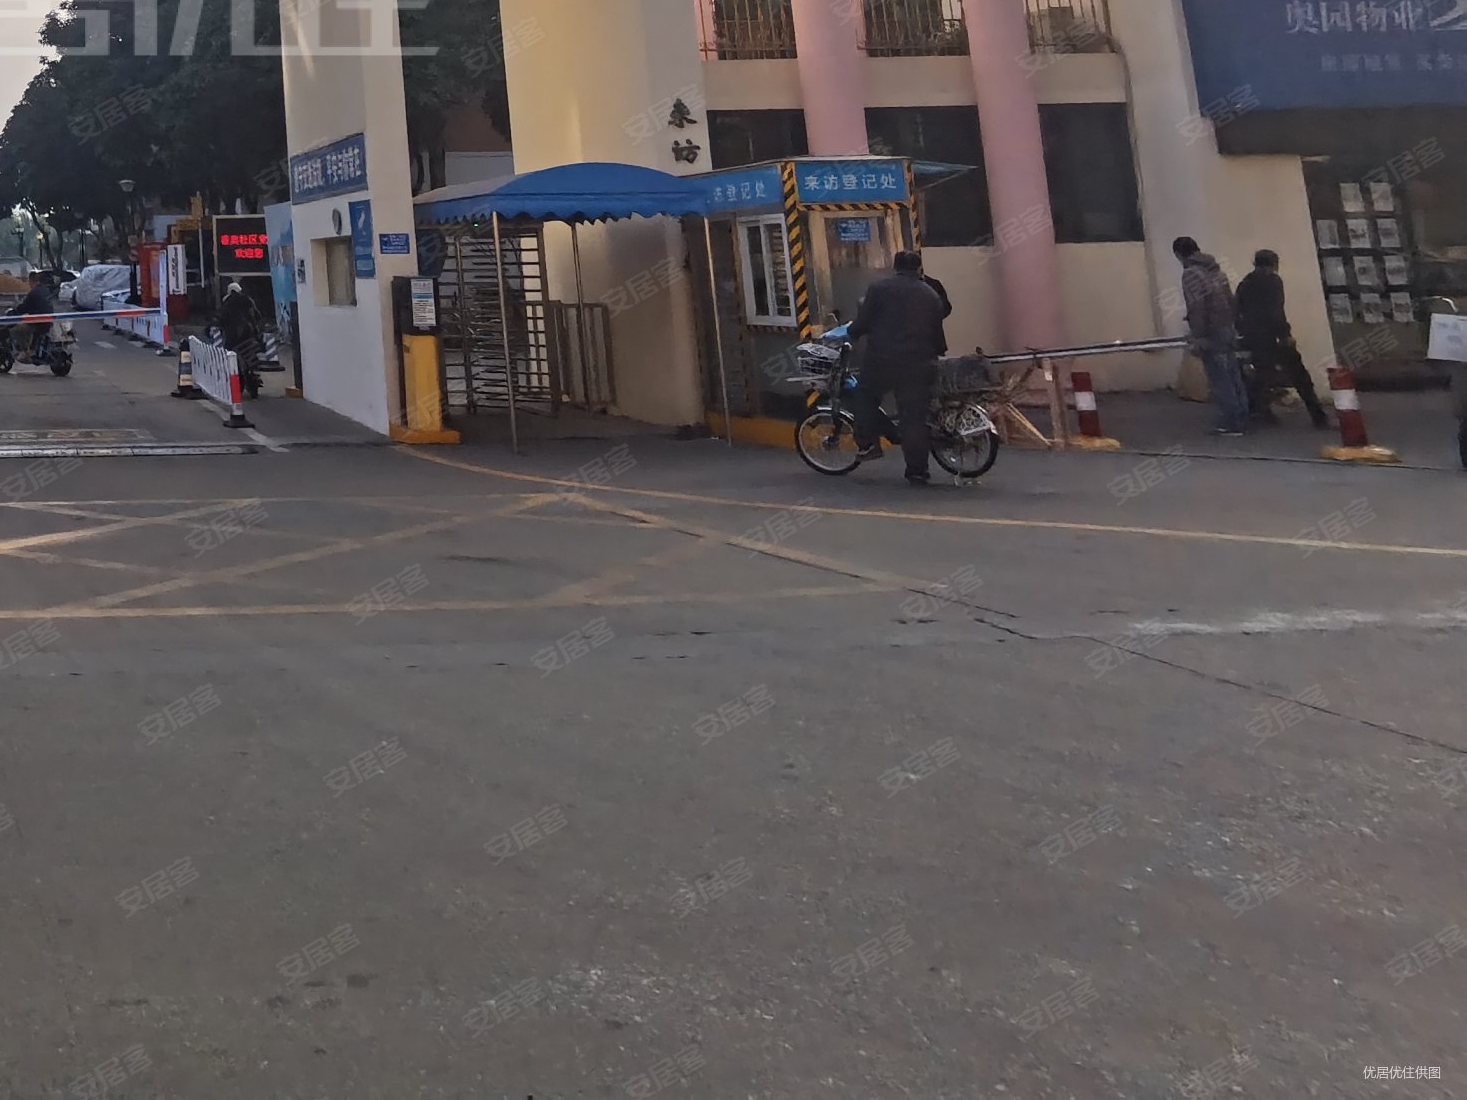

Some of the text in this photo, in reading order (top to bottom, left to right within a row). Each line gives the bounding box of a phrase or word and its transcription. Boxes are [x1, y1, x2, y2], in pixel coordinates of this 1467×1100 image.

[1286, 0, 1422, 33] 奥园物业
[804, 173, 897, 191] 来访登记处
